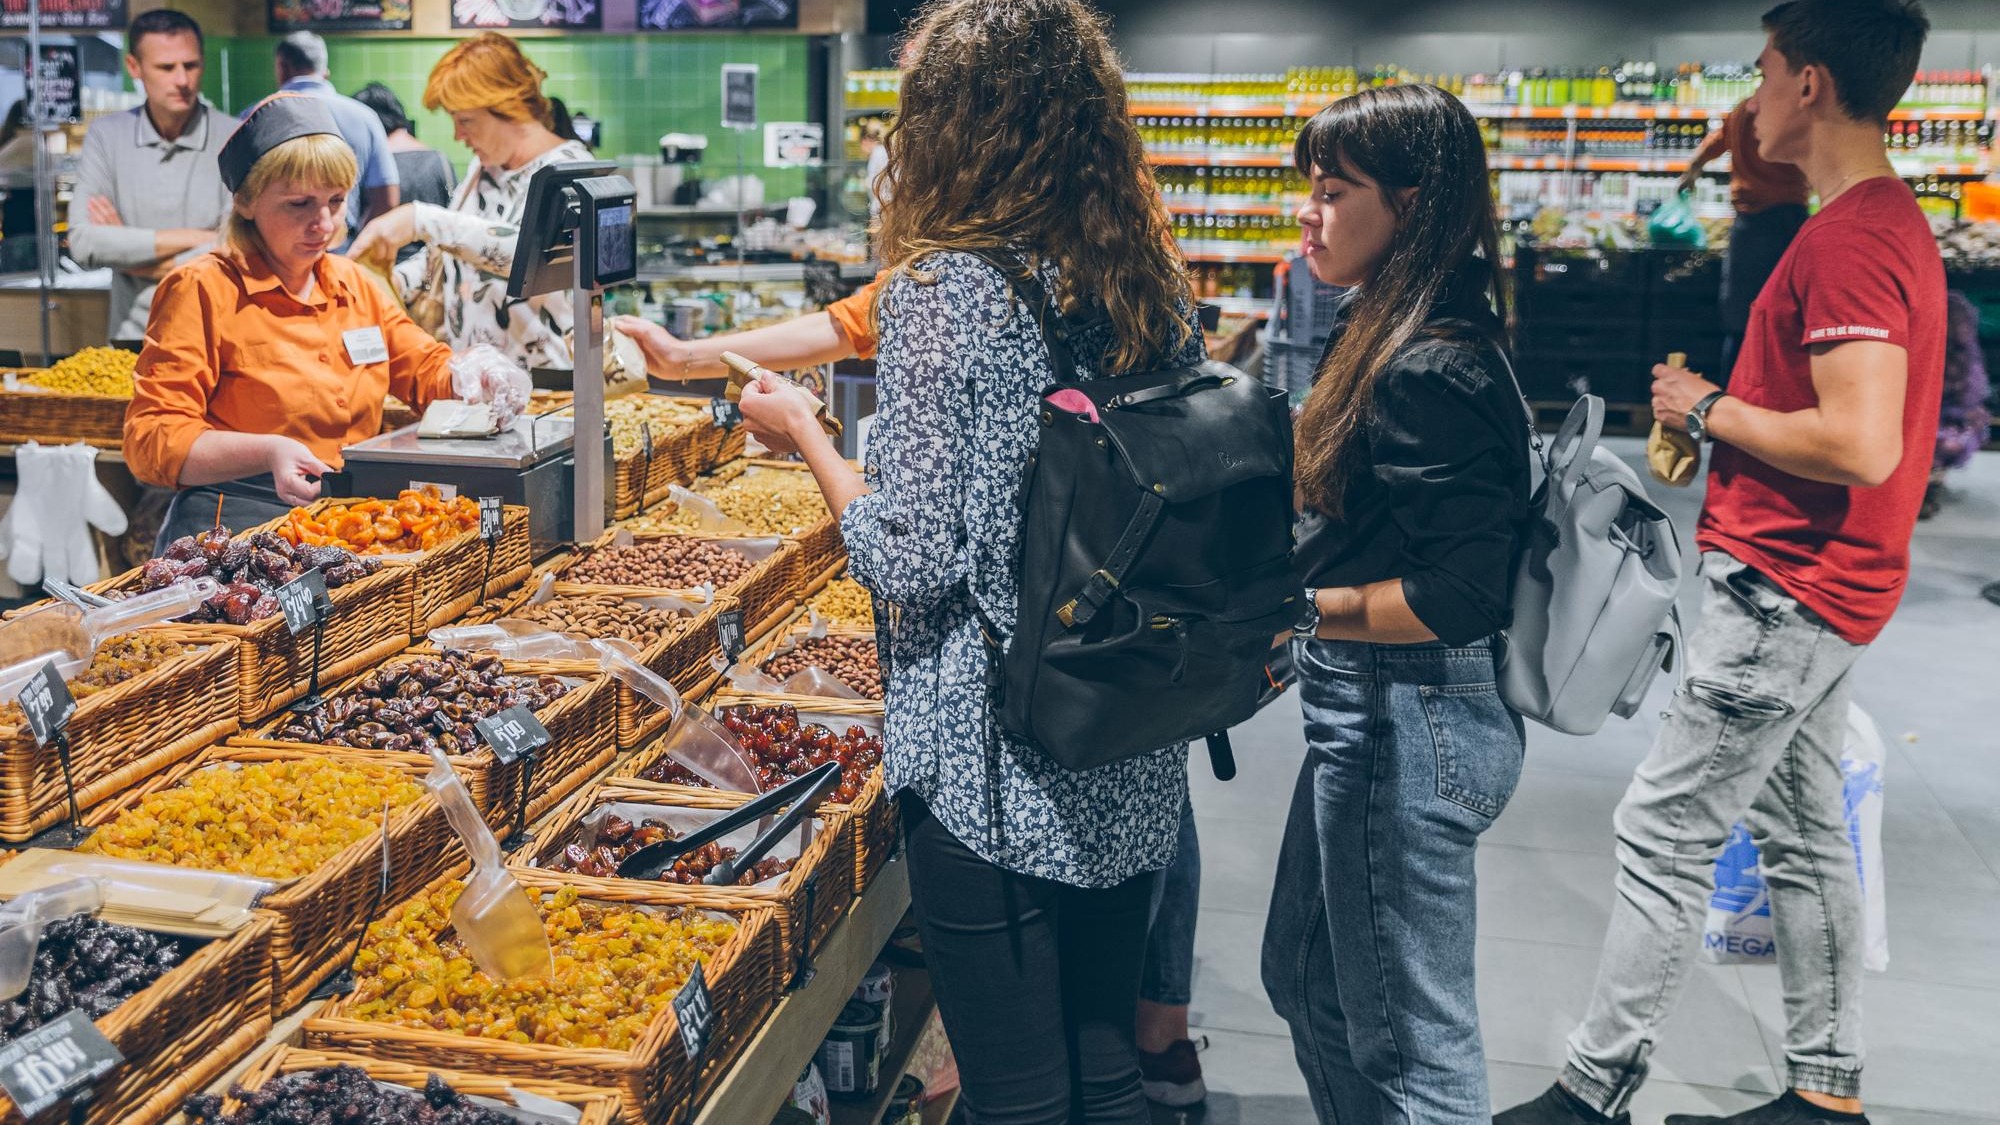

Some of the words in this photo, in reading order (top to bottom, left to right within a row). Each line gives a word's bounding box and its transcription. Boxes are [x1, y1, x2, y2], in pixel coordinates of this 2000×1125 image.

[1826, 326, 1837, 336] TO
[1837, 326, 1847, 335] BE
[1847, 325, 1889, 339] DIFFERENT
[1705, 934, 1777, 956] MEGA
